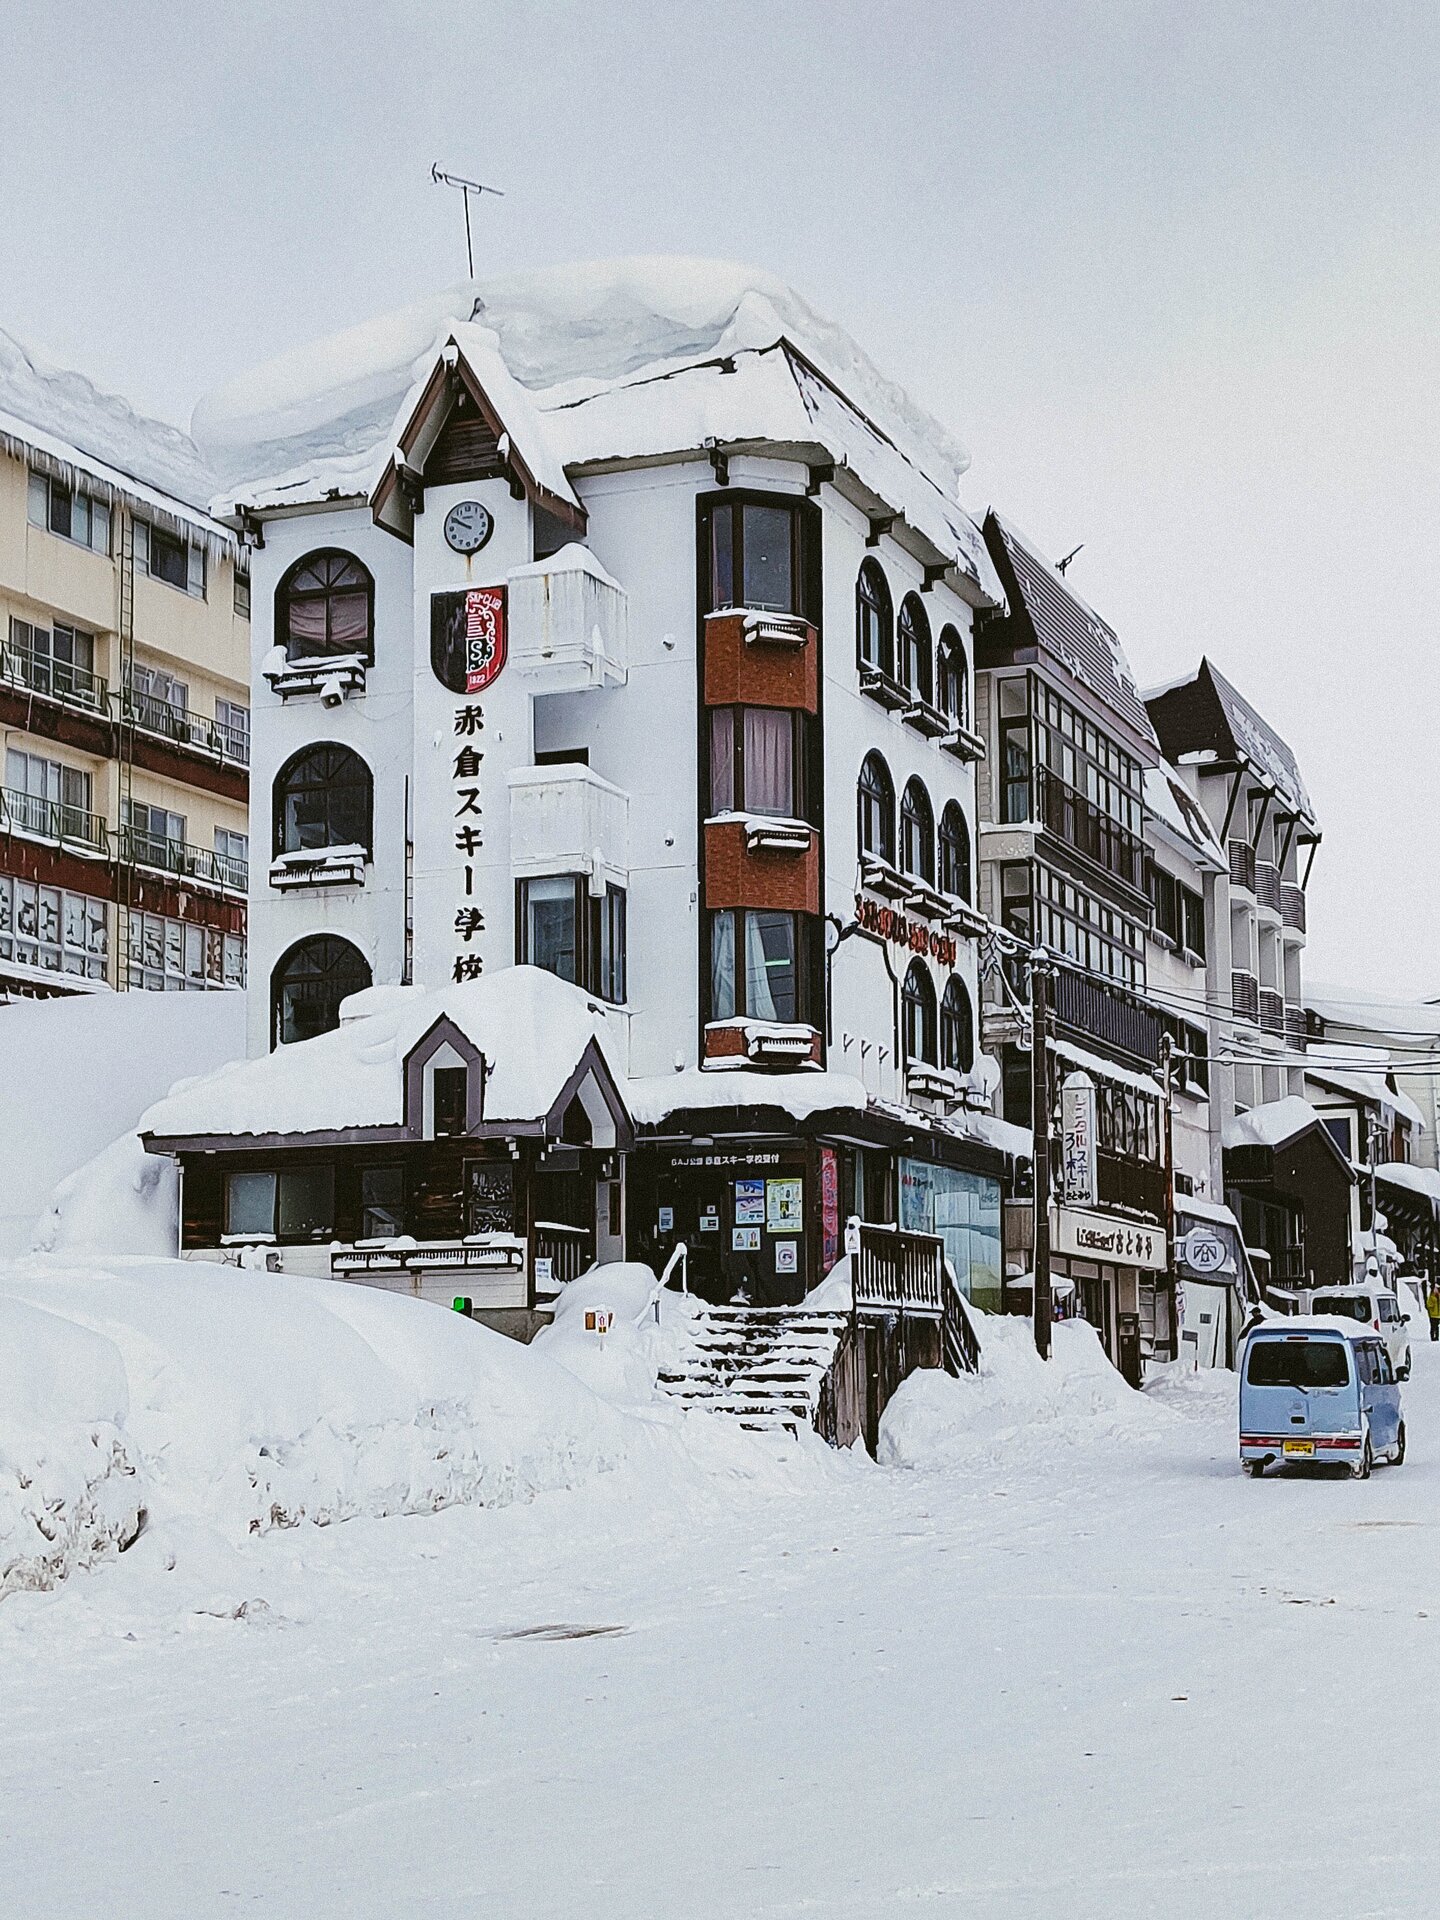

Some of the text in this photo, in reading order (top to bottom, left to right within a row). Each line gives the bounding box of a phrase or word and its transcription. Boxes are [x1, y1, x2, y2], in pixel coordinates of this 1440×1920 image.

[452, 704, 486, 984] 赤倉スキー学校
